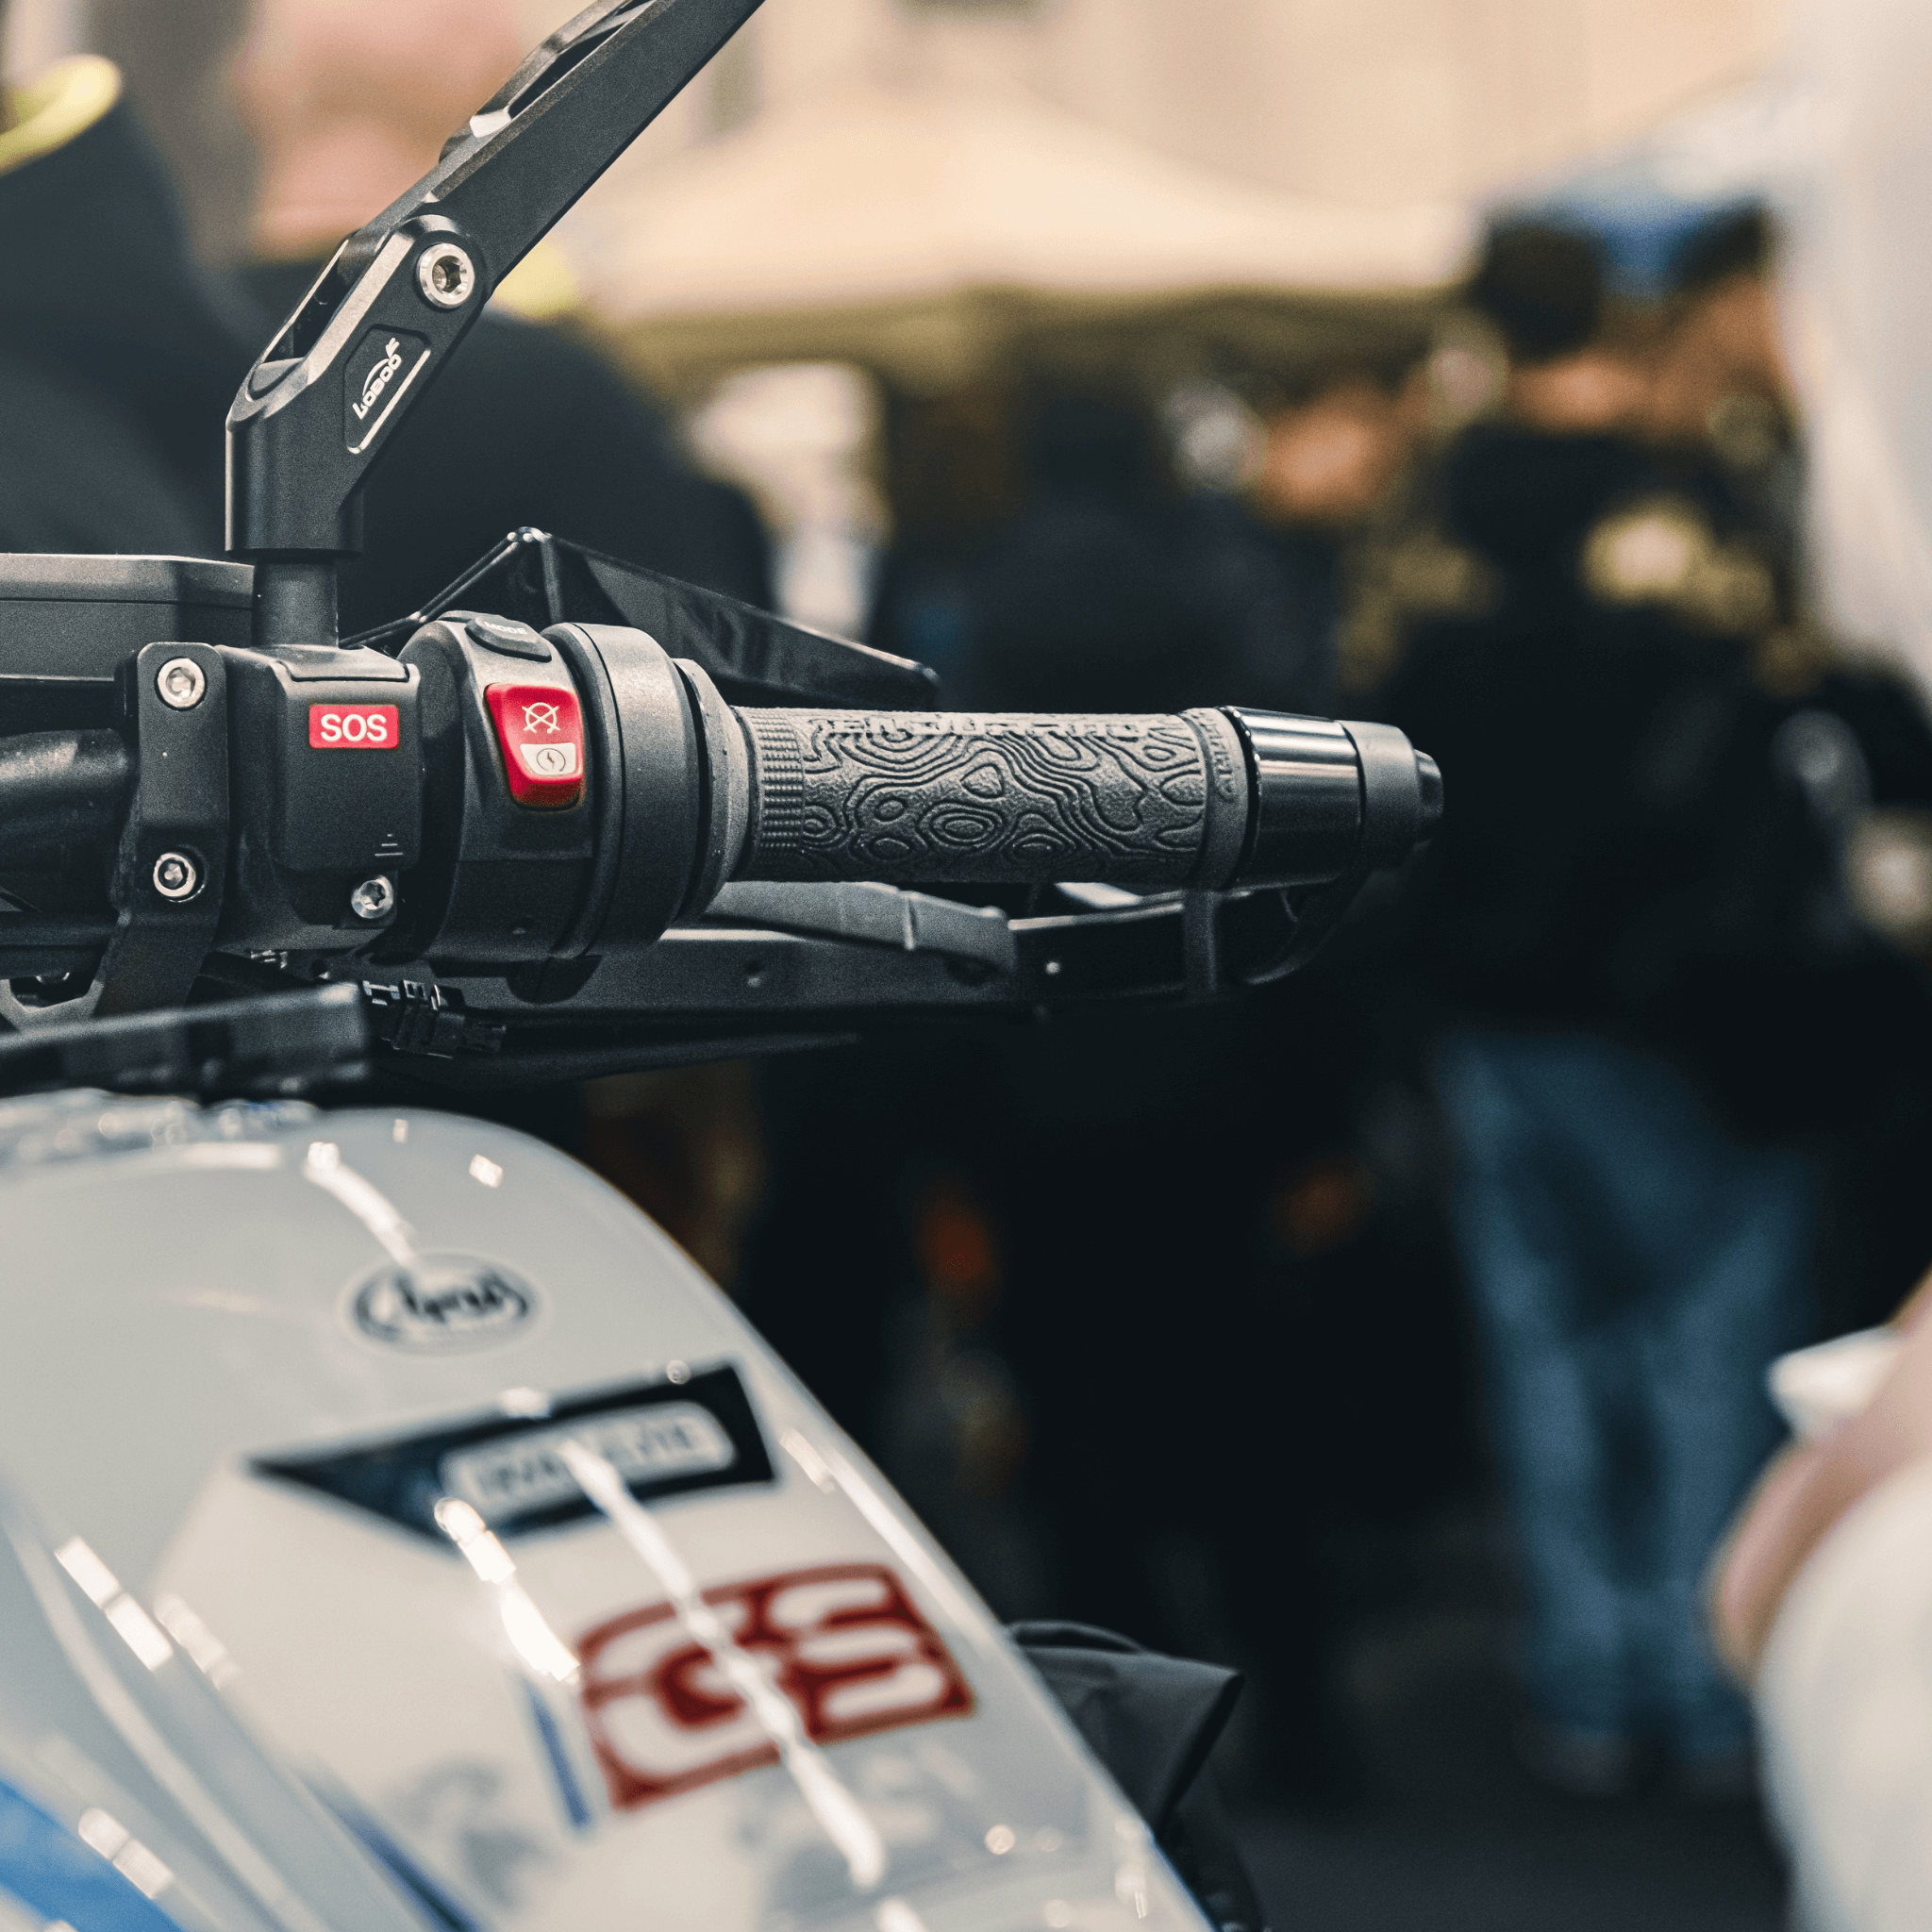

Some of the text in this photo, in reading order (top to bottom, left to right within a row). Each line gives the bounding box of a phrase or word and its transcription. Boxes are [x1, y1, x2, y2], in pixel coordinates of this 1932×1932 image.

[483, 621, 528, 635] MODE
[321, 713, 388, 742] SOS
[581, 1566, 970, 1804] GS
